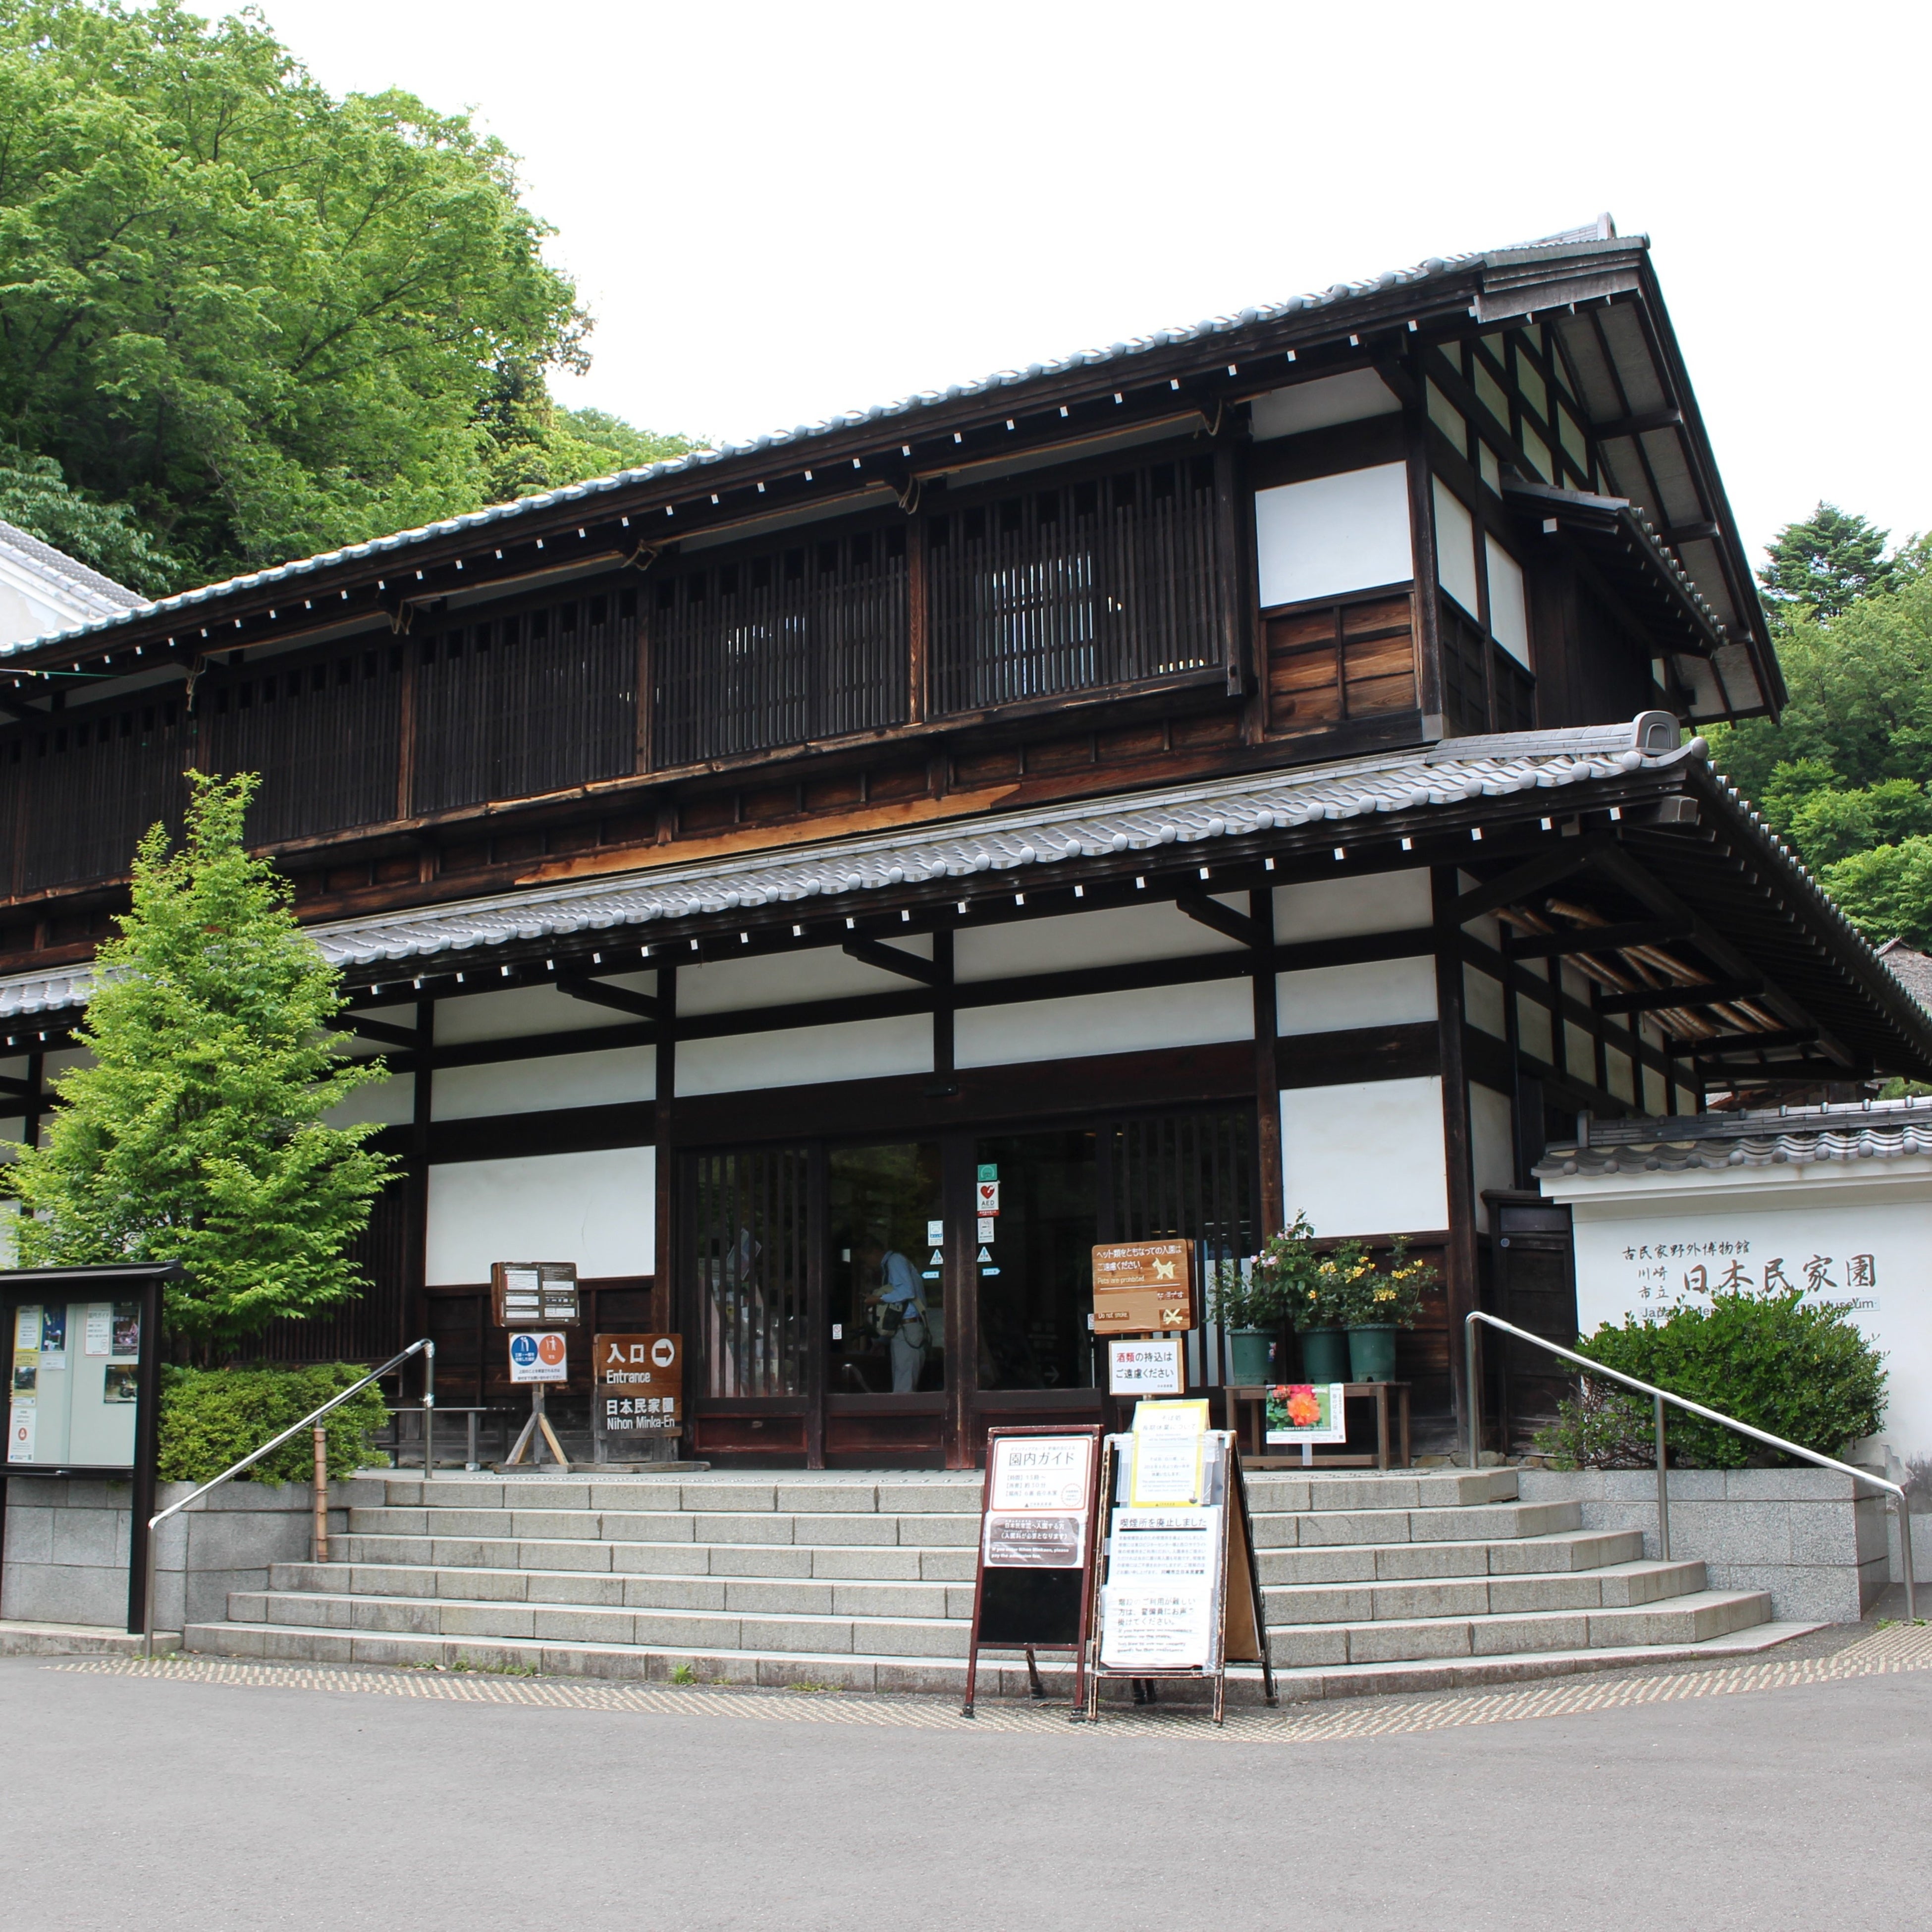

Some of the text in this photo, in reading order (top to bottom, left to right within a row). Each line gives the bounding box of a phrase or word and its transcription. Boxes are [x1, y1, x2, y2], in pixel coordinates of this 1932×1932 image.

[1622, 1239, 1750, 1261] 古民家野外博物館
[1638, 1265, 1668, 1281] 川崎
[1684, 1253, 1876, 1294] 日本民家園
[1638, 1285, 1669, 1300] 市立
[606, 1343, 644, 1364] 入口
[1116, 1351, 1173, 1363] 酒類の持込は
[606, 1369, 651, 1384] Entrance
[1116, 1368, 1174, 1379] ご遠慮ください
[606, 1397, 674, 1416] 日本民家園
[607, 1415, 675, 1431] Nihon Minka-En
[1009, 1451, 1074, 1466] 園内ガイド
[1120, 1517, 1207, 1528] 喫煙所を廃止しました
